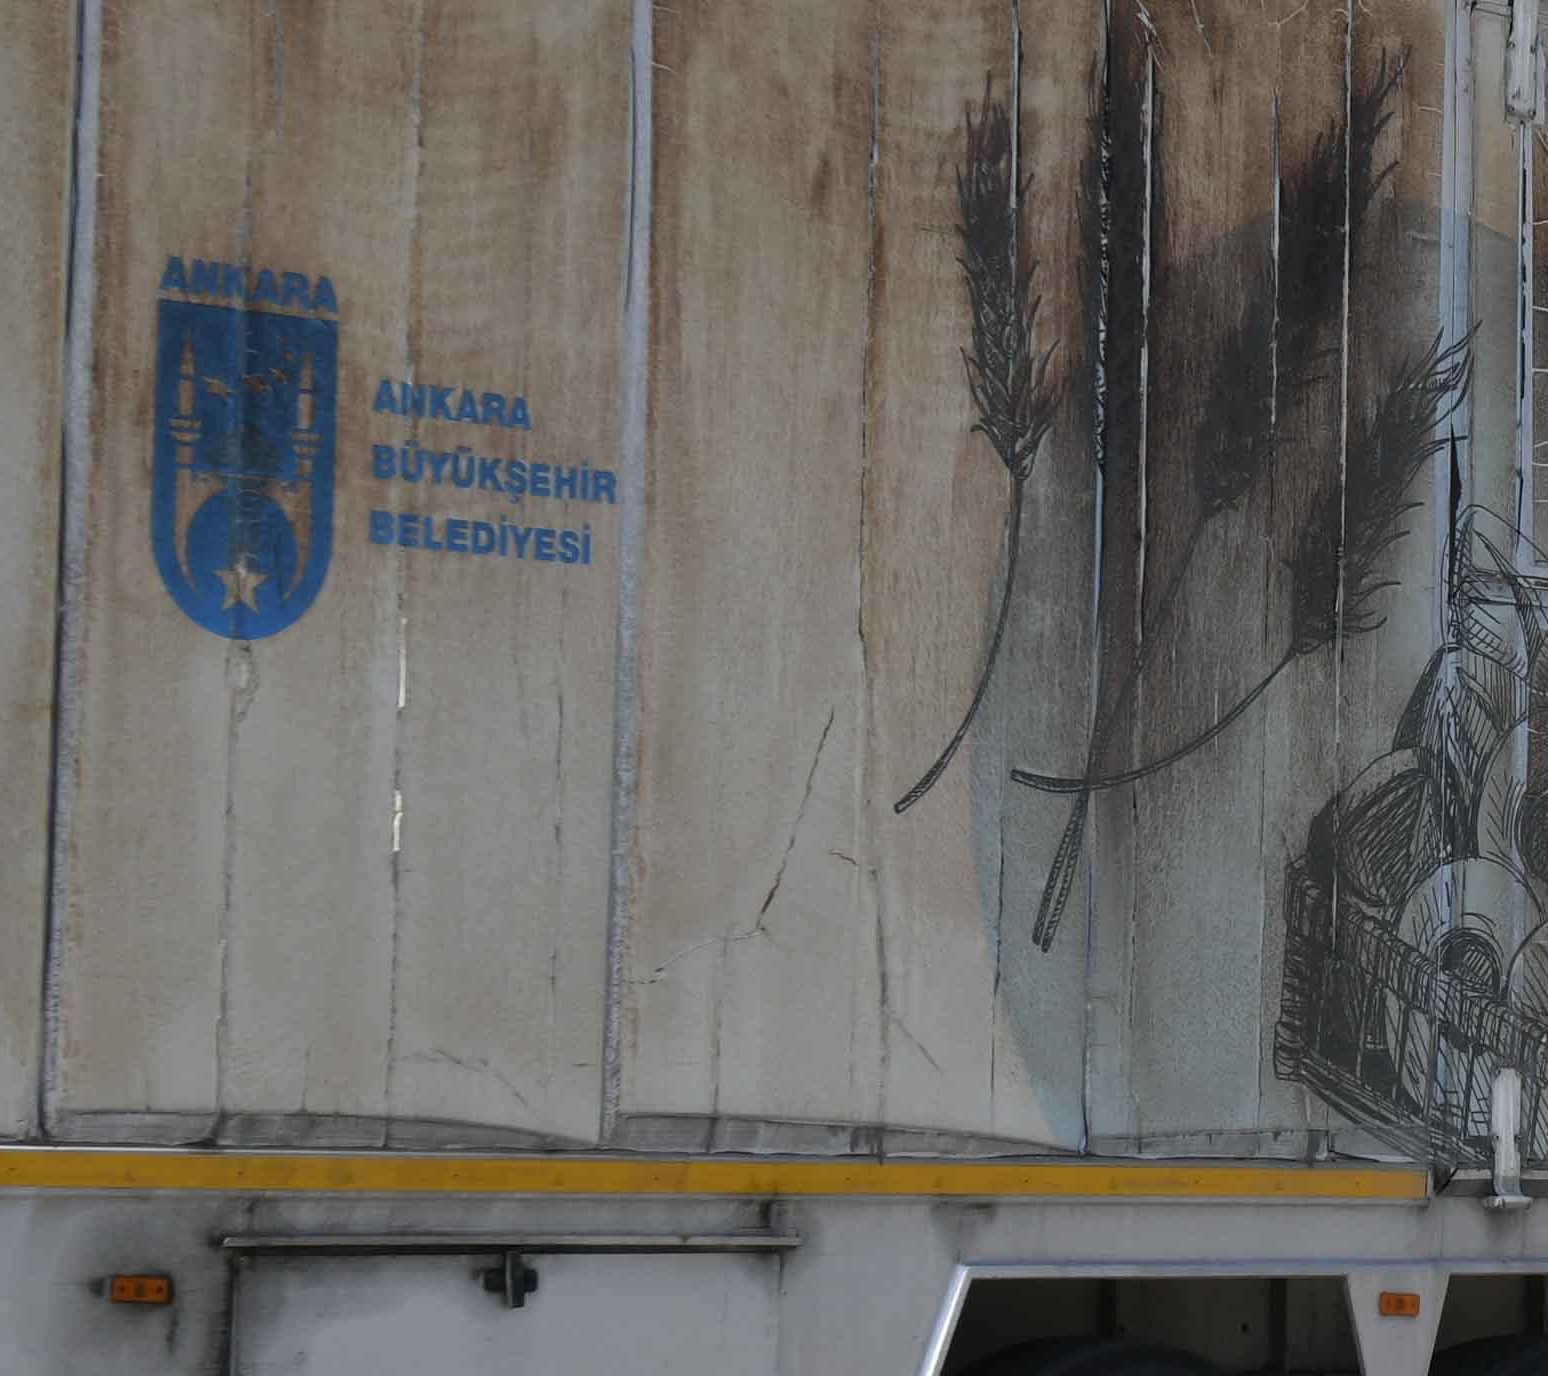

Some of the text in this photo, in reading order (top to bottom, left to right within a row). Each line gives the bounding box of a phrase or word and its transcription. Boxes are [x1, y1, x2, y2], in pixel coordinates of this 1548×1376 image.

[161, 256, 337, 313] ANKARA
[372, 379, 532, 431] ANKARA
[371, 444, 619, 504] BÜYÜKŞEHİR
[369, 509, 592, 566] BELEDİYESİ
